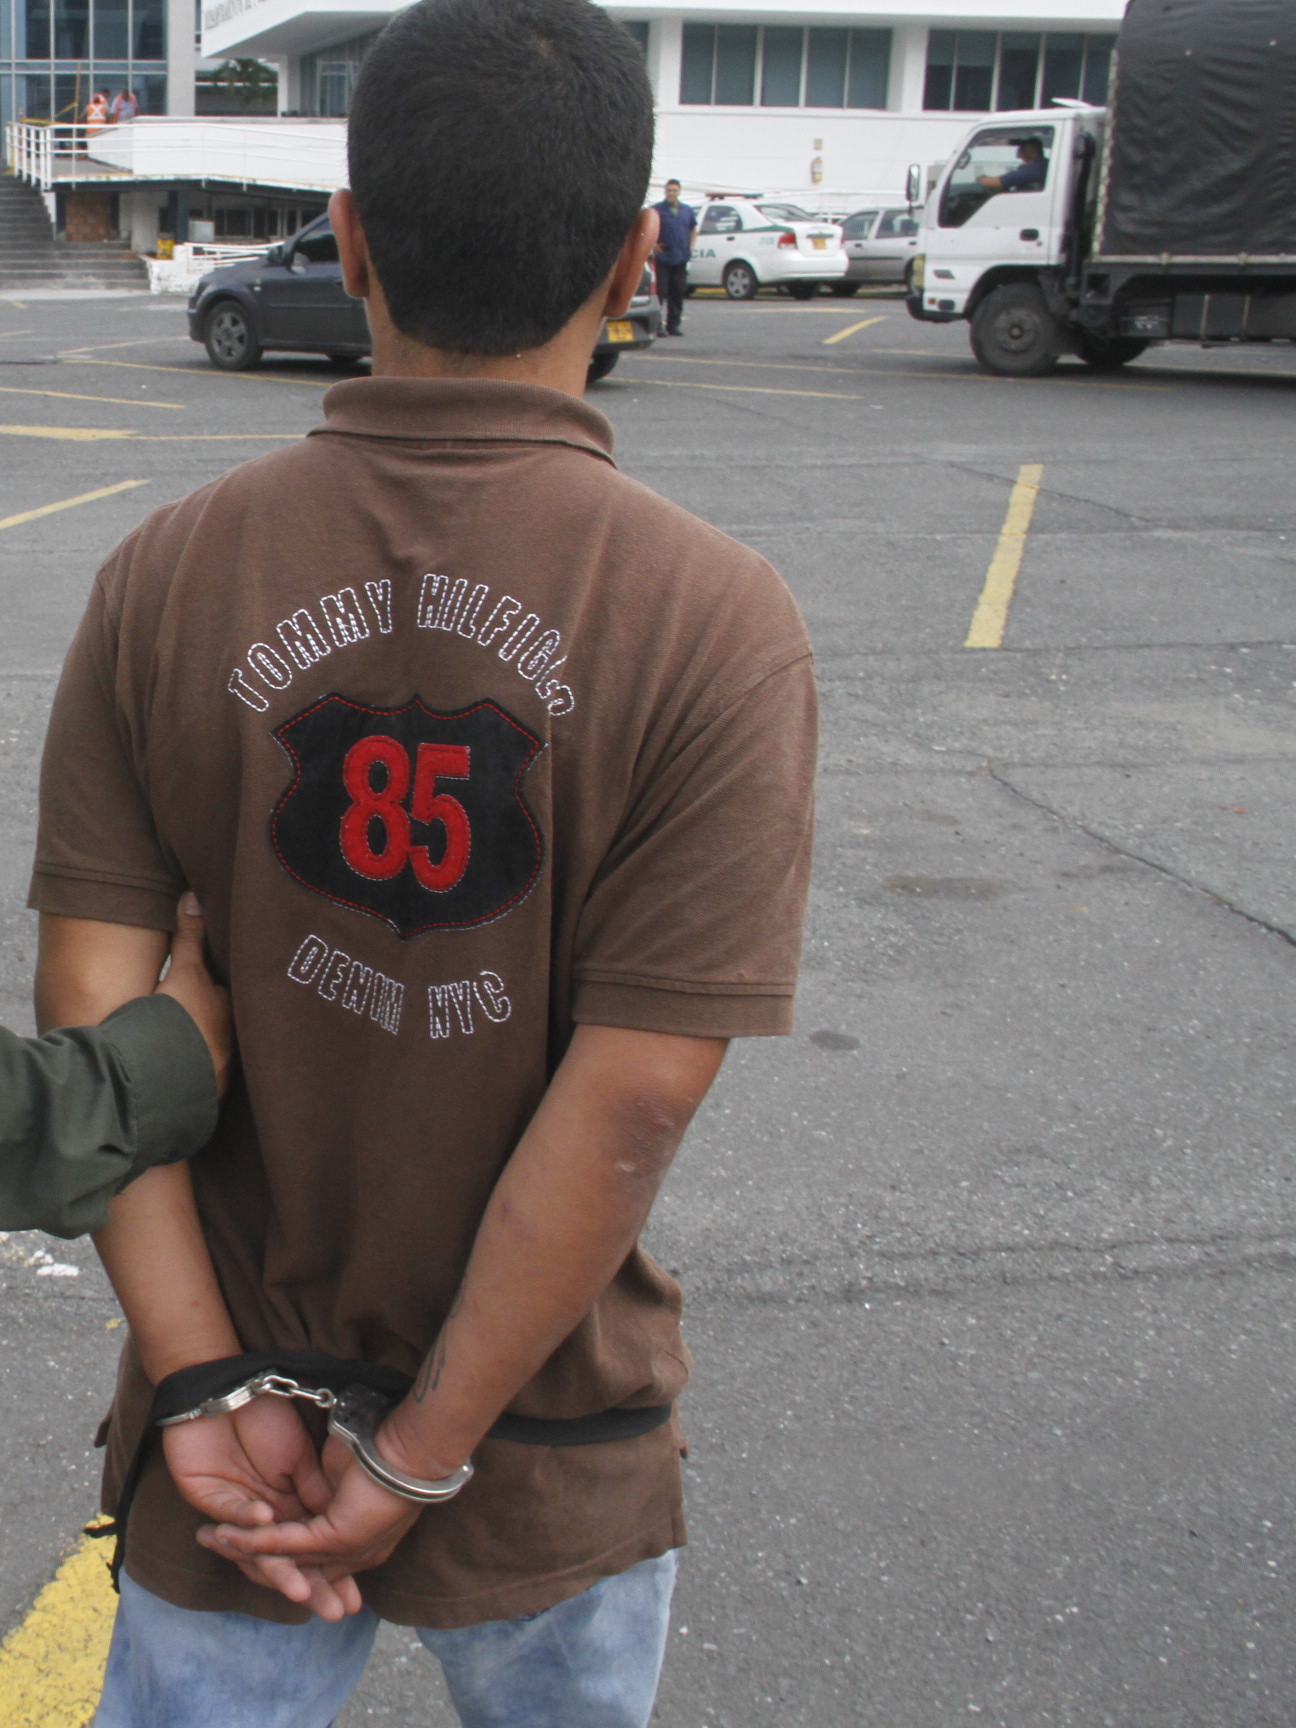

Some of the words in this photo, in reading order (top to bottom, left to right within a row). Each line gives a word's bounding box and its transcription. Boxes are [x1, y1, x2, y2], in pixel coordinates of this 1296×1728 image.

[227, 578, 393, 713] TOMMY
[338, 734, 472, 894] 85
[286, 933, 405, 1036] DENIM
[427, 969, 512, 1040] NYC
